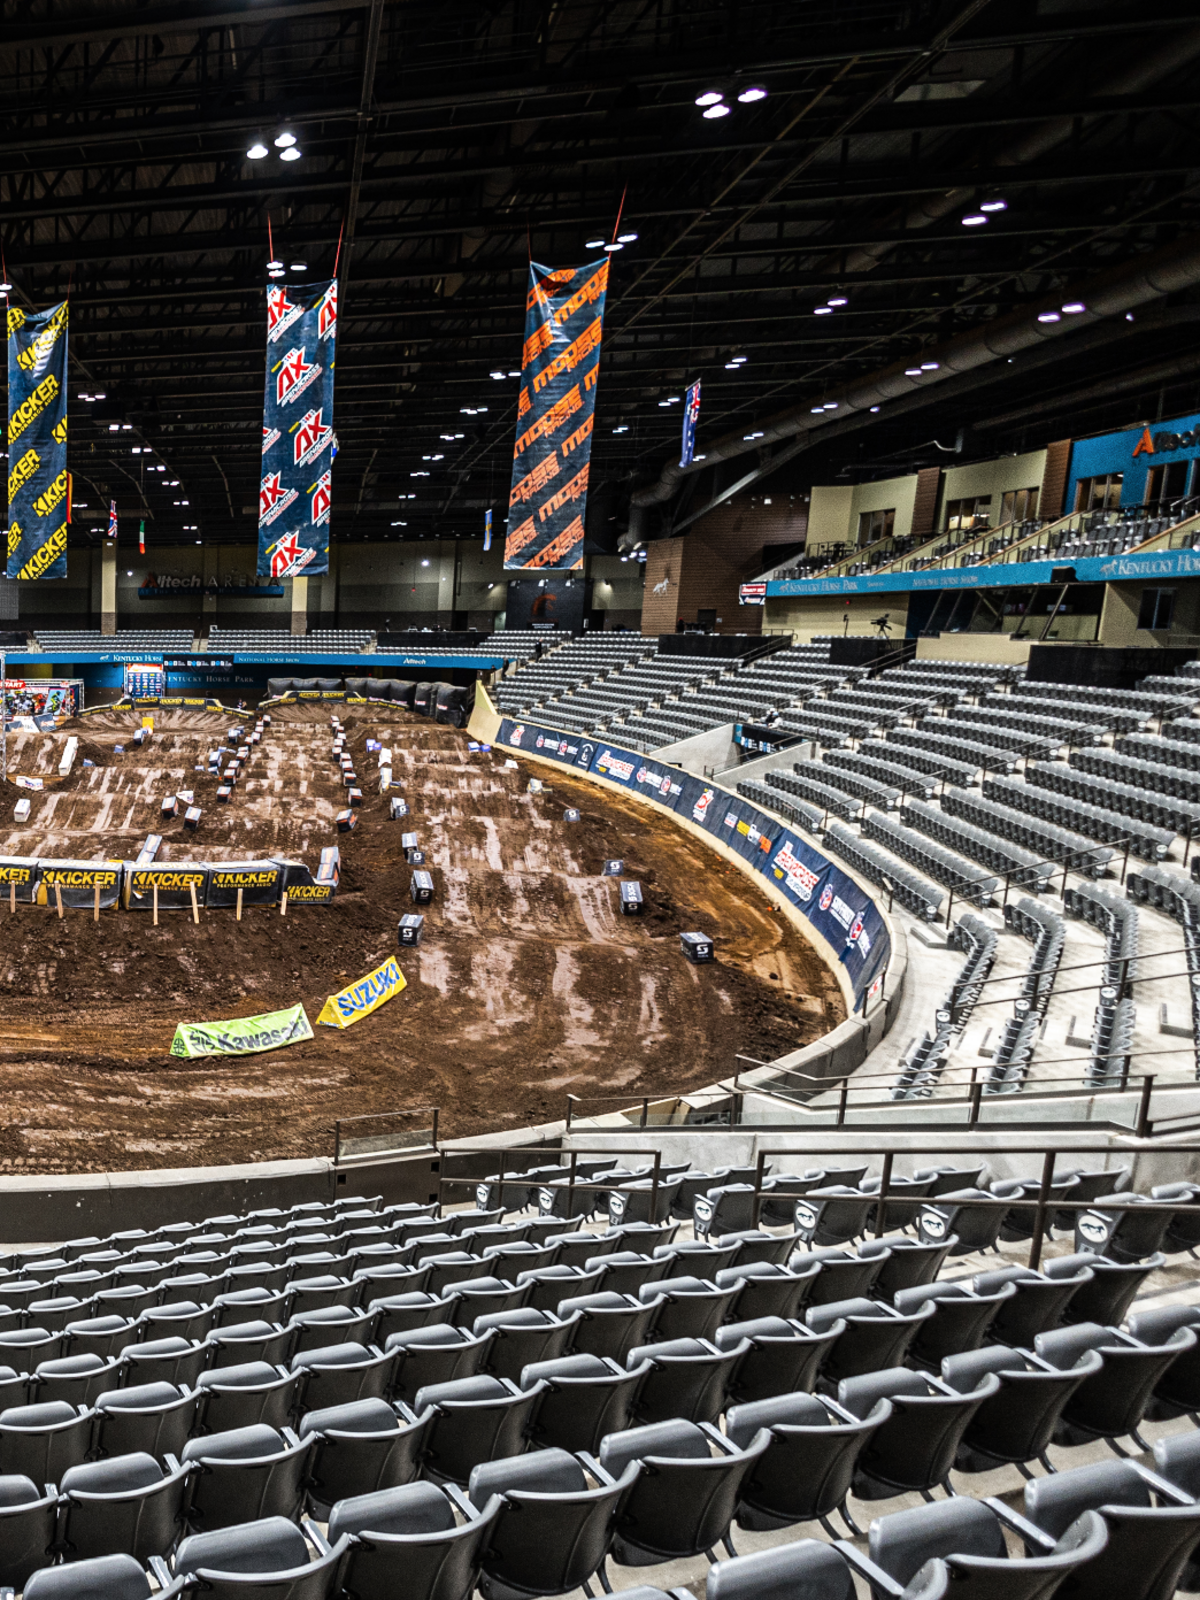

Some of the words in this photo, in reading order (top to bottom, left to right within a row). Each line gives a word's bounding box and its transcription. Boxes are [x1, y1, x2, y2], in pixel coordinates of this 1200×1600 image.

[532, 316, 602, 393] MOOSE
[277, 352, 314, 404] AX
[281, 364, 320, 406] ARENACROSS
[10, 374, 60, 437] KICKER
[11, 407, 43, 443] PERFORMANCE
[44, 389, 58, 407] AUDIO
[514, 383, 580, 459] MOOSE
[544, 401, 584, 438] RACING
[294, 412, 331, 464] AX
[27, 463, 40, 480] AUDIO
[522, 467, 561, 503] RACING
[271, 534, 306, 577] AX
[549, 530, 584, 566] RACING
[141, 572, 201, 588] Alltech
[1118, 558, 1173, 575] KENTUCKY
[788, 580, 819, 594] KENTUCKY
[820, 579, 841, 592] HORSE
[843, 579, 858, 590] PARK
[113, 654, 143, 662] KENTUCKY
[403, 656, 427, 665] Alltech
[206, 674, 230, 682] HORSE
[235, 675, 254, 683] PARK
[55, 871, 117, 886] KICKER
[147, 872, 205, 887] KICKER
[225, 869, 277, 884] KICKER
[294, 886, 330, 897] KICKER
[337, 963, 400, 1017] SUZUKI
[217, 1015, 310, 1051] Kawasaki
